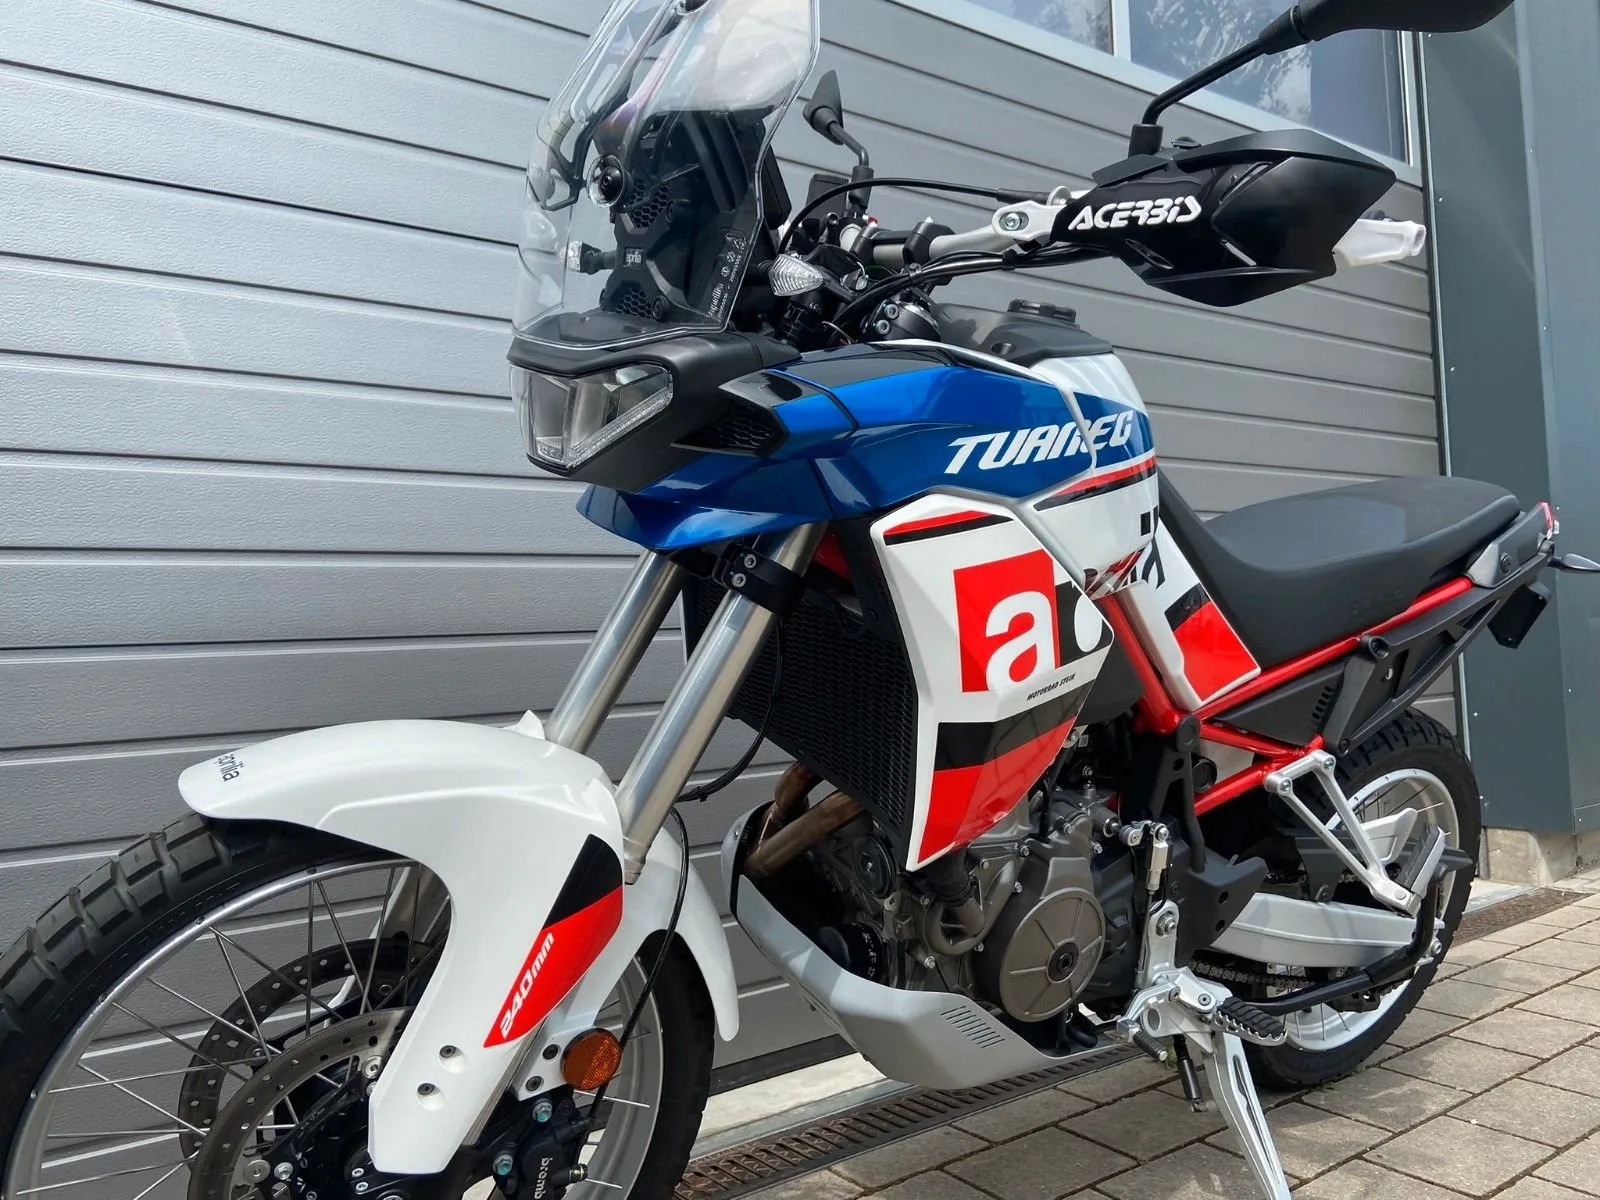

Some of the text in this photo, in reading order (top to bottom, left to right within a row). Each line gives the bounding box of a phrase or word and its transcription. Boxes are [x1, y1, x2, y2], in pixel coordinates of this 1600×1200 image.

[1068, 195, 1202, 230] ACERBIS
[944, 410, 1133, 474] TUAREG
[500, 932, 555, 1040] 240mm
